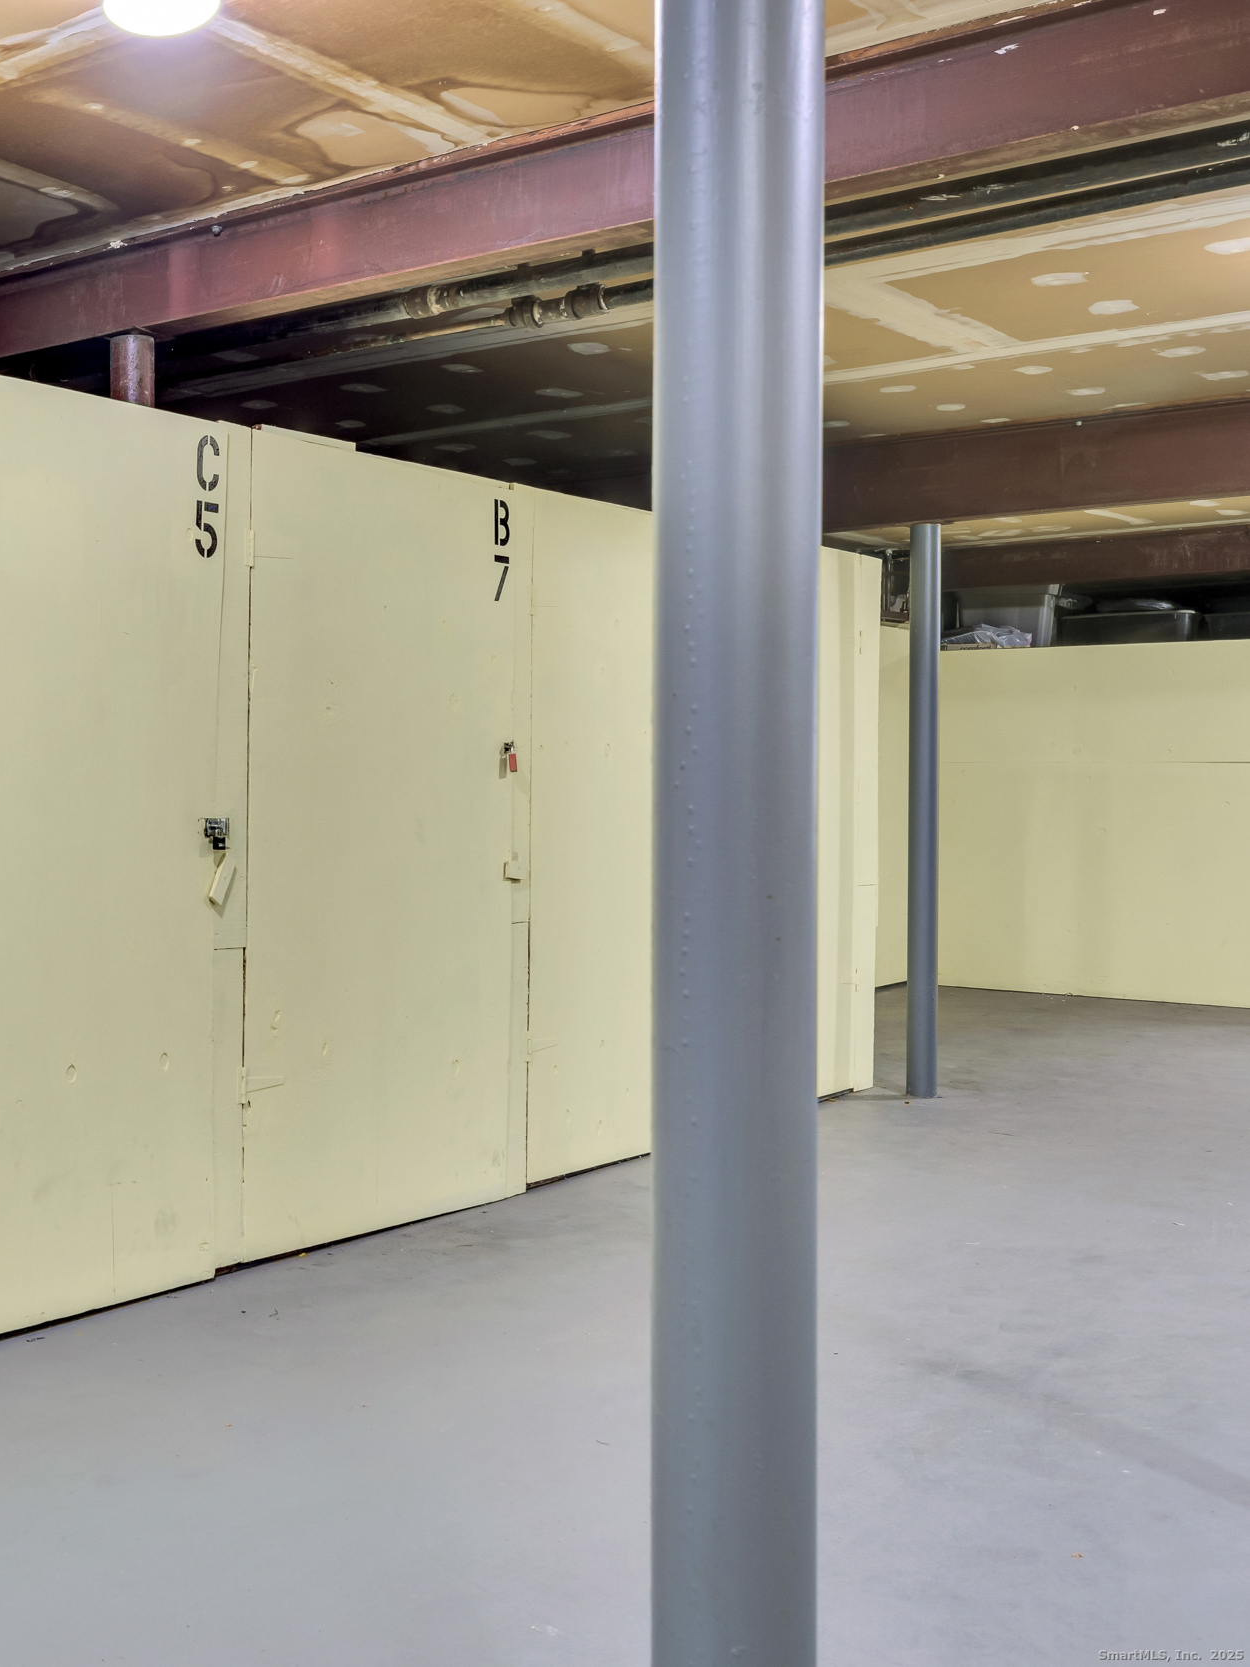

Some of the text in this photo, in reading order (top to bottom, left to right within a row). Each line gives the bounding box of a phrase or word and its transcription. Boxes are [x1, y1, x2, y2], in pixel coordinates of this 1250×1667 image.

[197, 435, 220, 492] C
[195, 499, 220, 559] 5
[494, 498, 510, 547] B
[494, 554, 510, 602] 7
